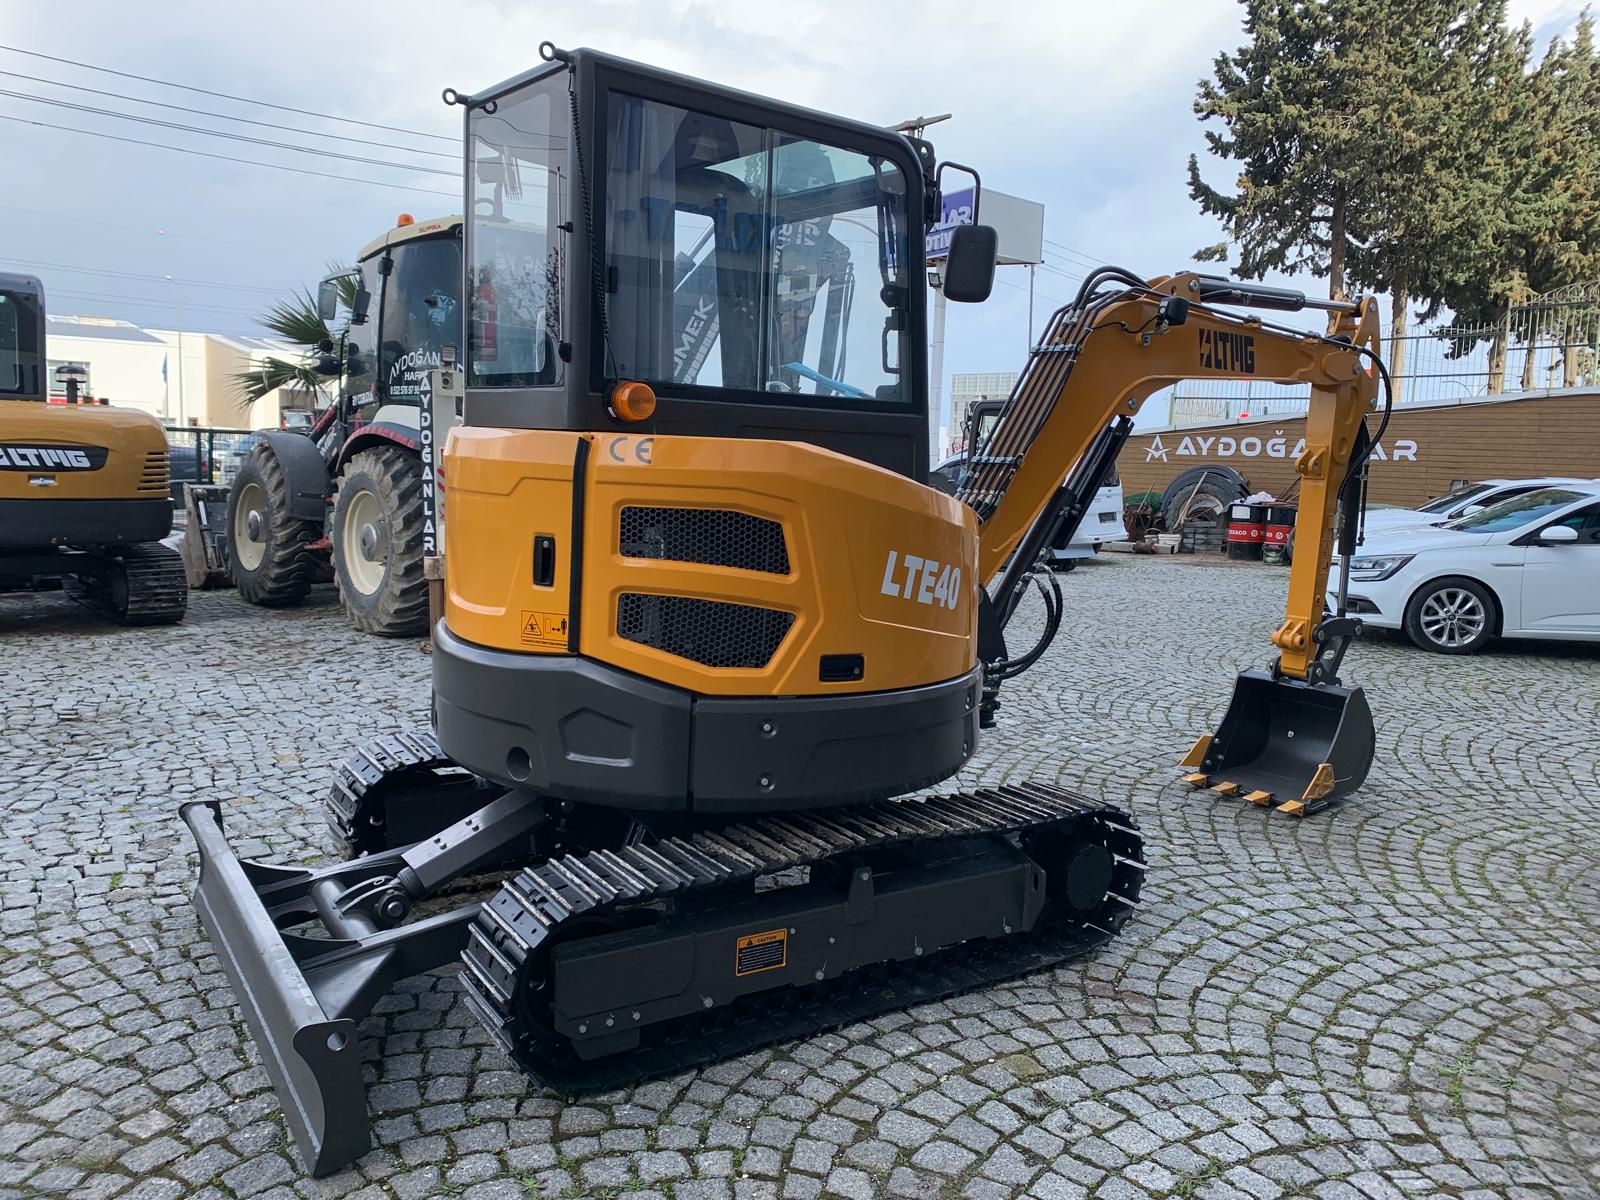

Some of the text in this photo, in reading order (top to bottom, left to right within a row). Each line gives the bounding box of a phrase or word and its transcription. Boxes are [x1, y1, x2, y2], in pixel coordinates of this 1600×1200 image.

[420, 376, 435, 552] AYDOĞANLAR
[609, 436, 655, 465] CE
[880, 550, 961, 610] LTE40
